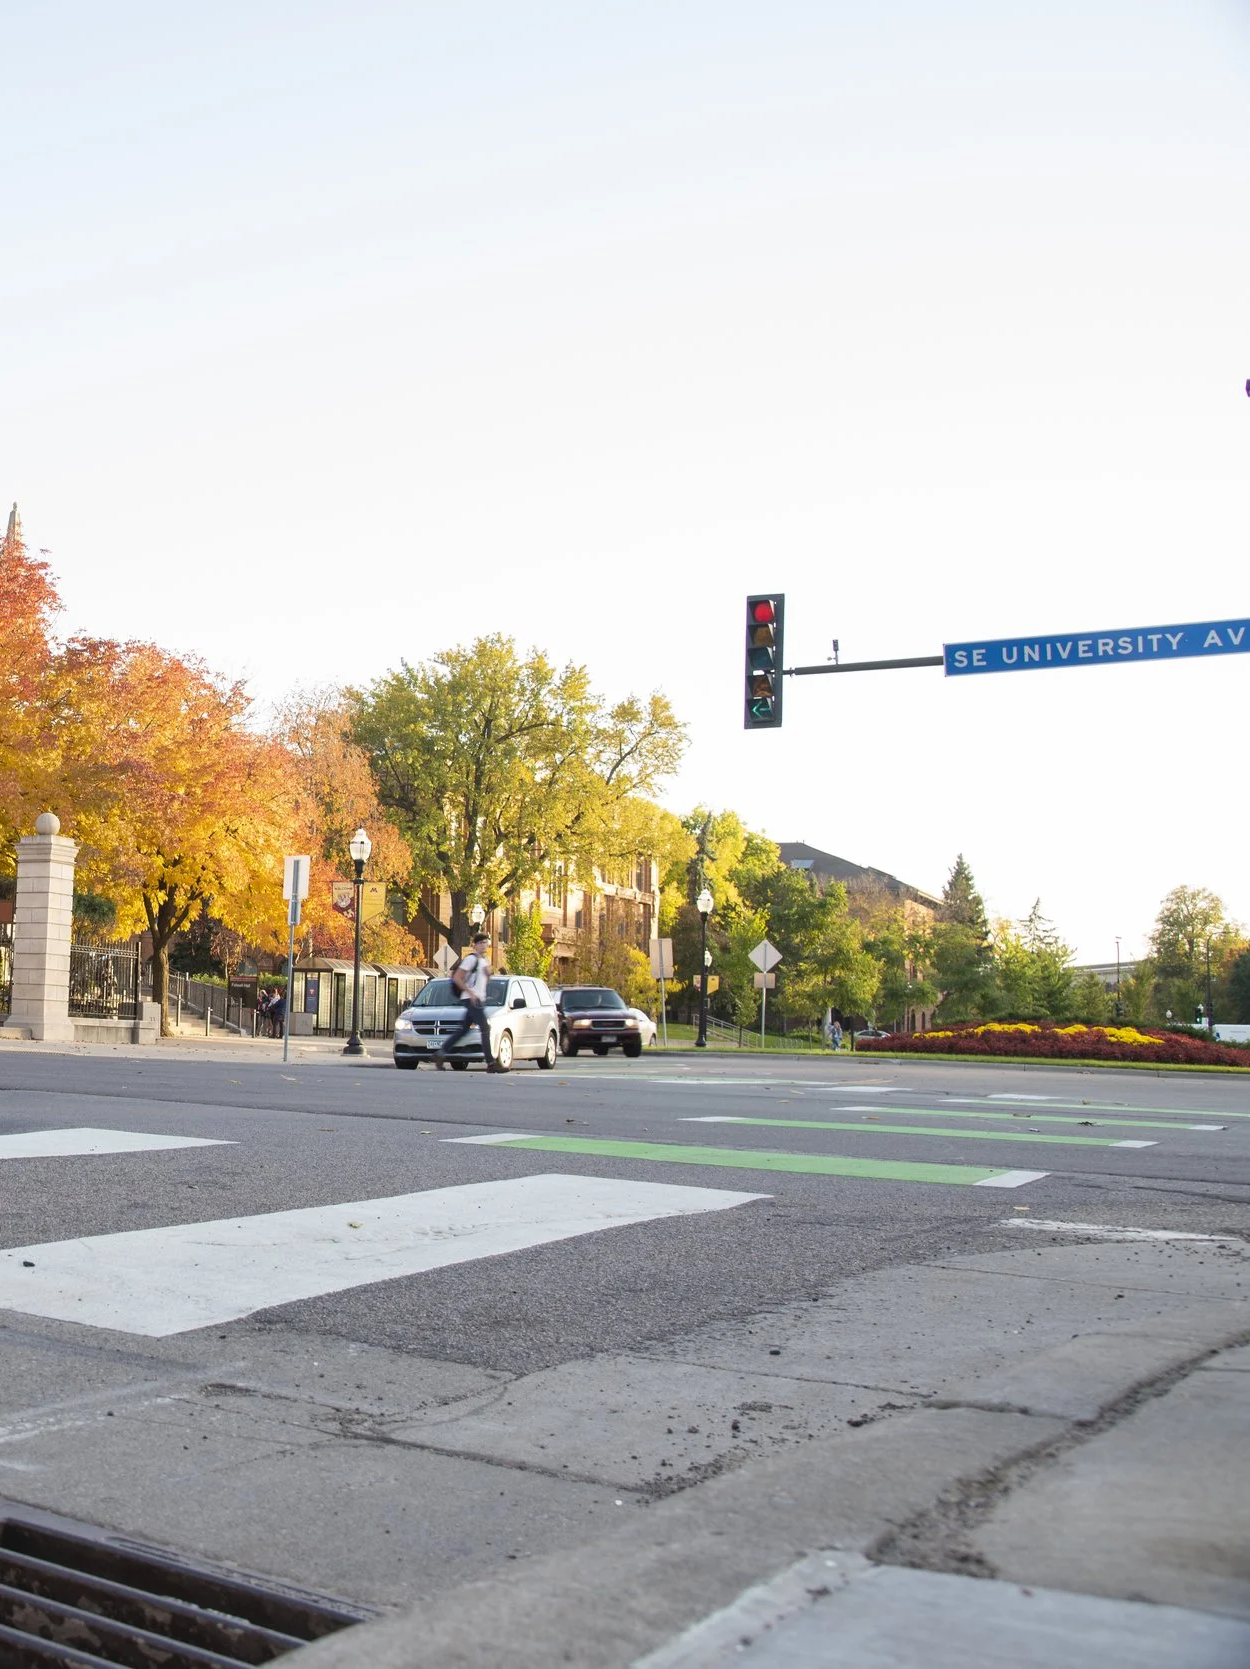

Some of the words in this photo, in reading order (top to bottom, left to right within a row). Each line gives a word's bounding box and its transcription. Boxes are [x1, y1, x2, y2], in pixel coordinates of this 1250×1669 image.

[953, 648, 987, 668] SE
[1002, 632, 1184, 664] UNIVERSITY
[1203, 627, 1246, 648] AV
